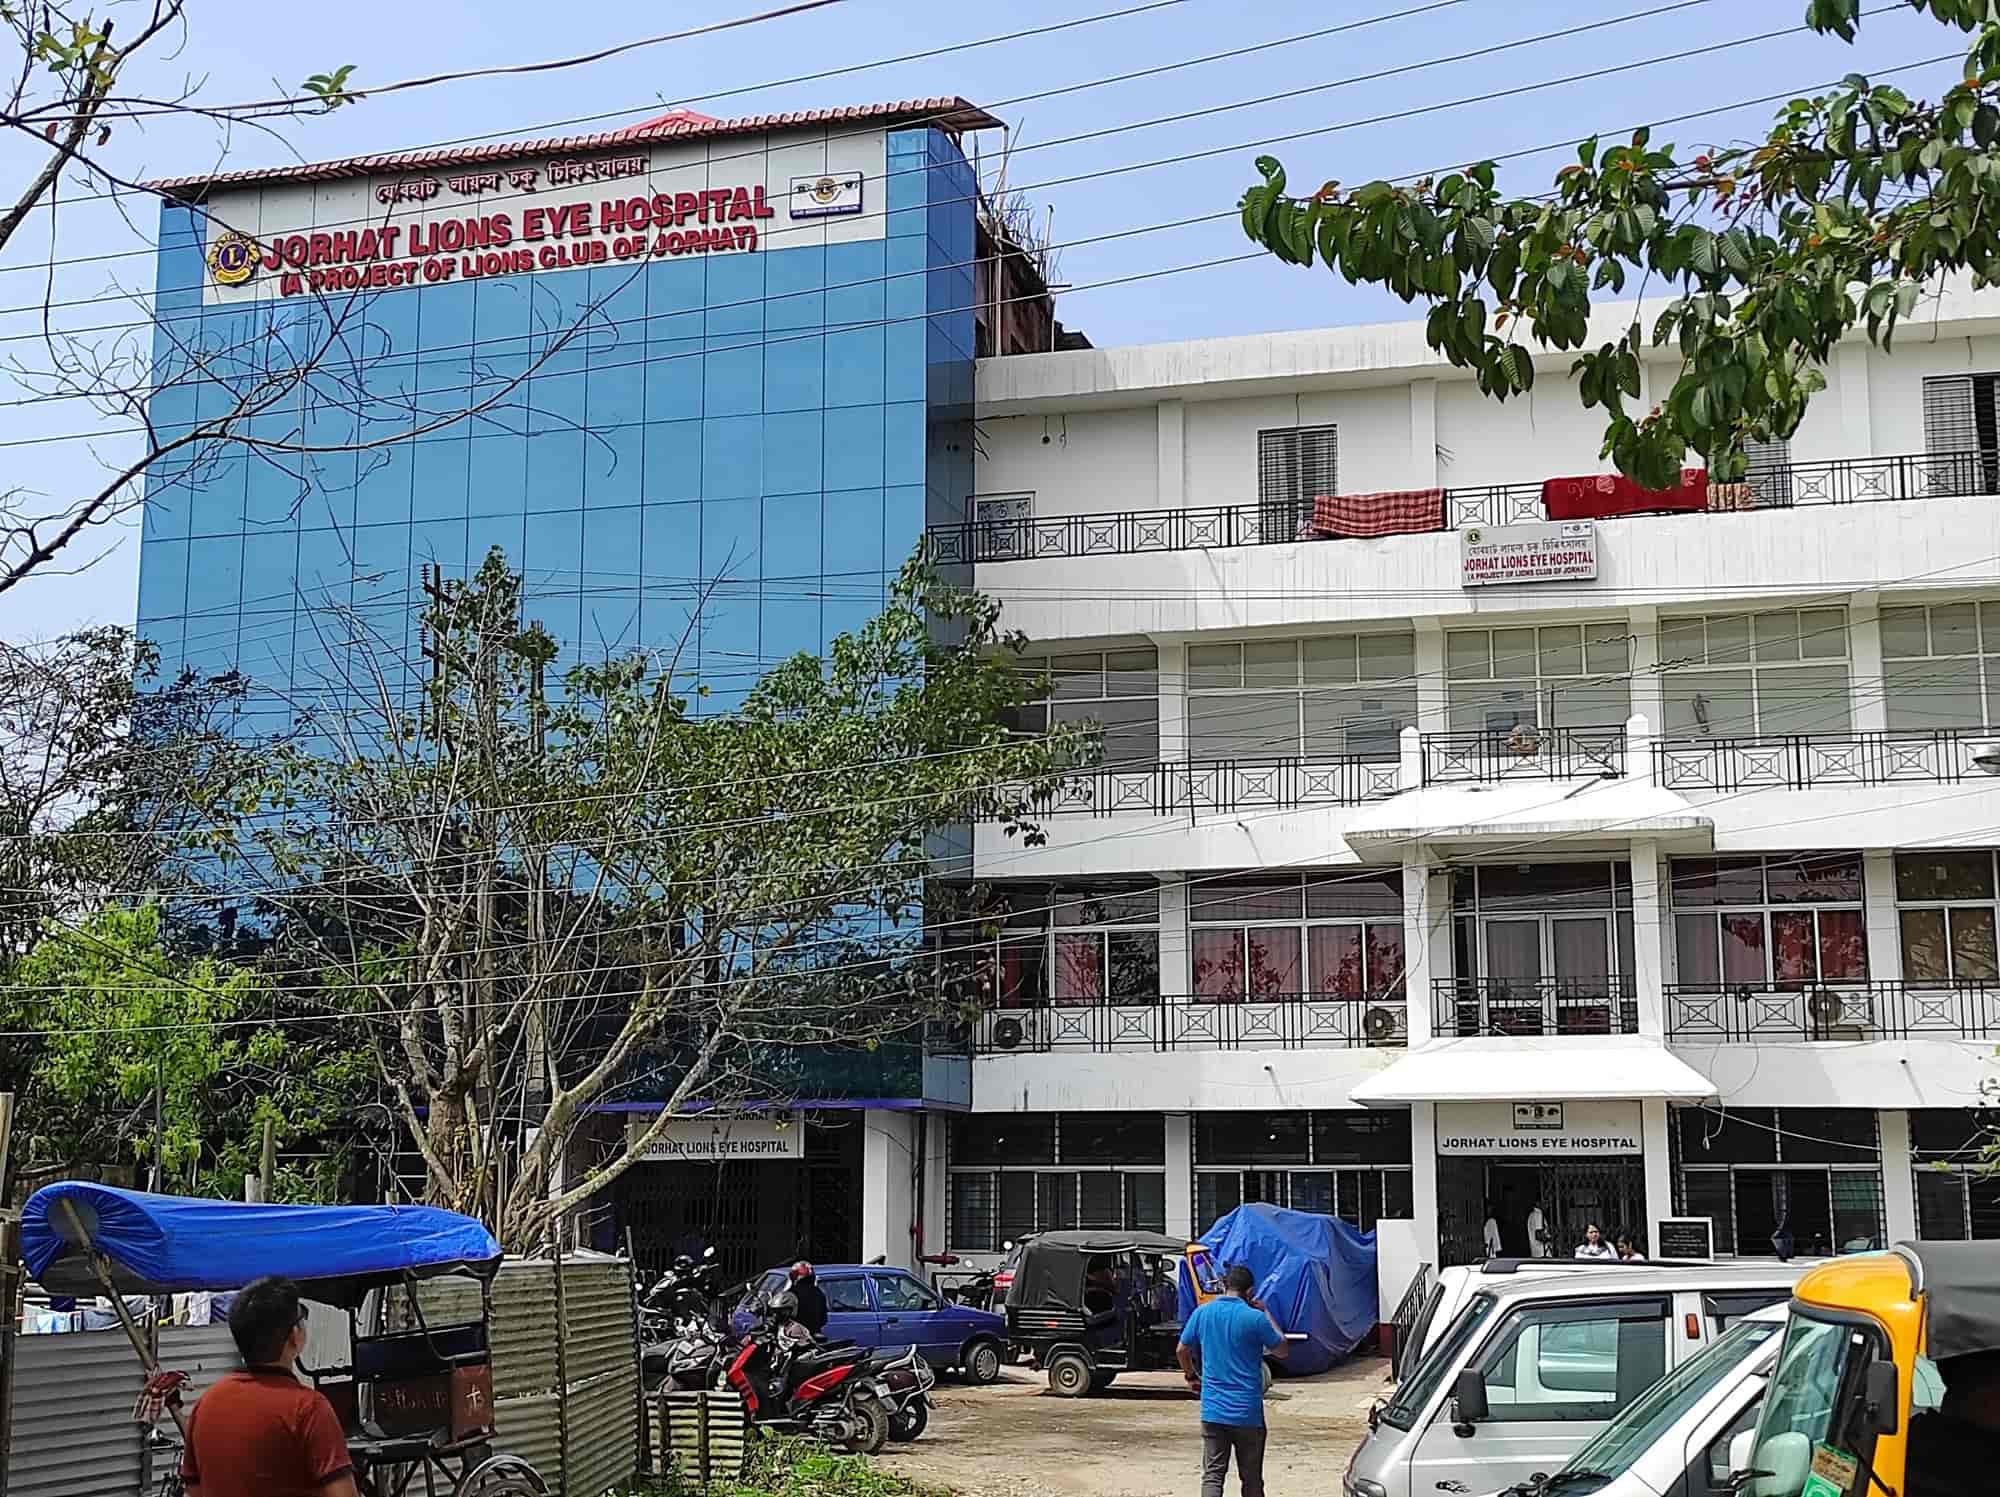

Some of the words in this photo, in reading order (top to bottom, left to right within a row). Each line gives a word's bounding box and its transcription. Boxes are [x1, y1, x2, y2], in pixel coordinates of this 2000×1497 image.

[263, 226, 400, 271] JORHAT
[408, 211, 513, 257] LIONS
[522, 202, 592, 242] EYE
[600, 184, 775, 234] HOSPITAL
[280, 272, 303, 297] (A
[308, 261, 417, 291] PROJECT
[423, 256, 456, 281] OF
[462, 248, 535, 278] LIONS
[539, 239, 608, 269] CLUB
[613, 234, 648, 260] OF
[653, 225, 758, 257] JORHAT)
[1463, 556, 1499, 572] JORHAT
[1501, 554, 1529, 569] LIONS
[1530, 552, 1549, 568] EYE
[1549, 551, 1594, 566] HOSPITAL
[645, 1141, 684, 1154] JORHAT
[686, 1141, 716, 1153] LIONS
[719, 1140, 738, 1153] EYE
[740, 1140, 789, 1153] HOSPITAL
[1442, 1138, 1496, 1149] JORHAT
[1498, 1137, 1539, 1149] LIONS
[1541, 1137, 1568, 1149] EYE
[1571, 1137, 1637, 1149] HOSPITAL
